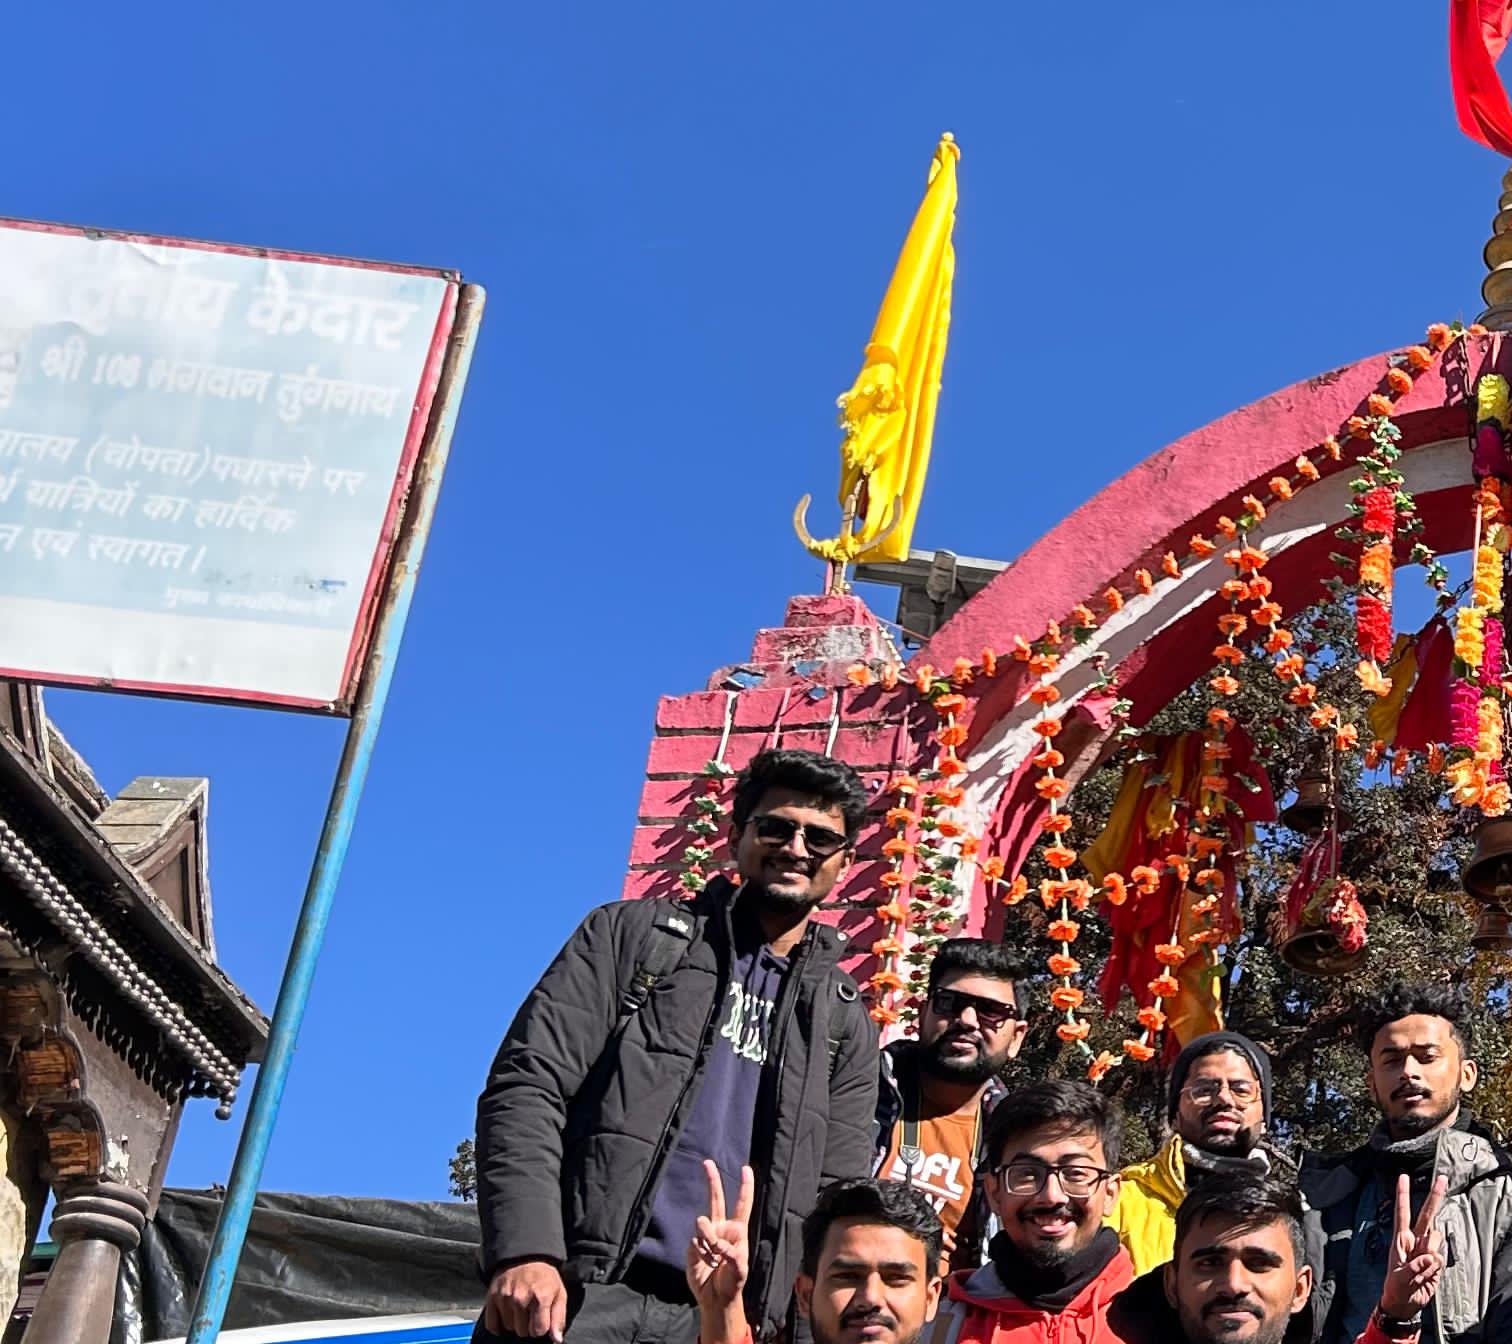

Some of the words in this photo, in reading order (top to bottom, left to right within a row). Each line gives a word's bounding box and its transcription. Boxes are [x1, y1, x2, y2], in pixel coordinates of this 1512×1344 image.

[40, 336, 88, 384] श्री
[92, 351, 143, 388] 108
[147, 356, 274, 404] भगवान
[322, 466, 367, 496] पर
[143, 492, 191, 522] का
[32, 519, 84, 560] एवं
